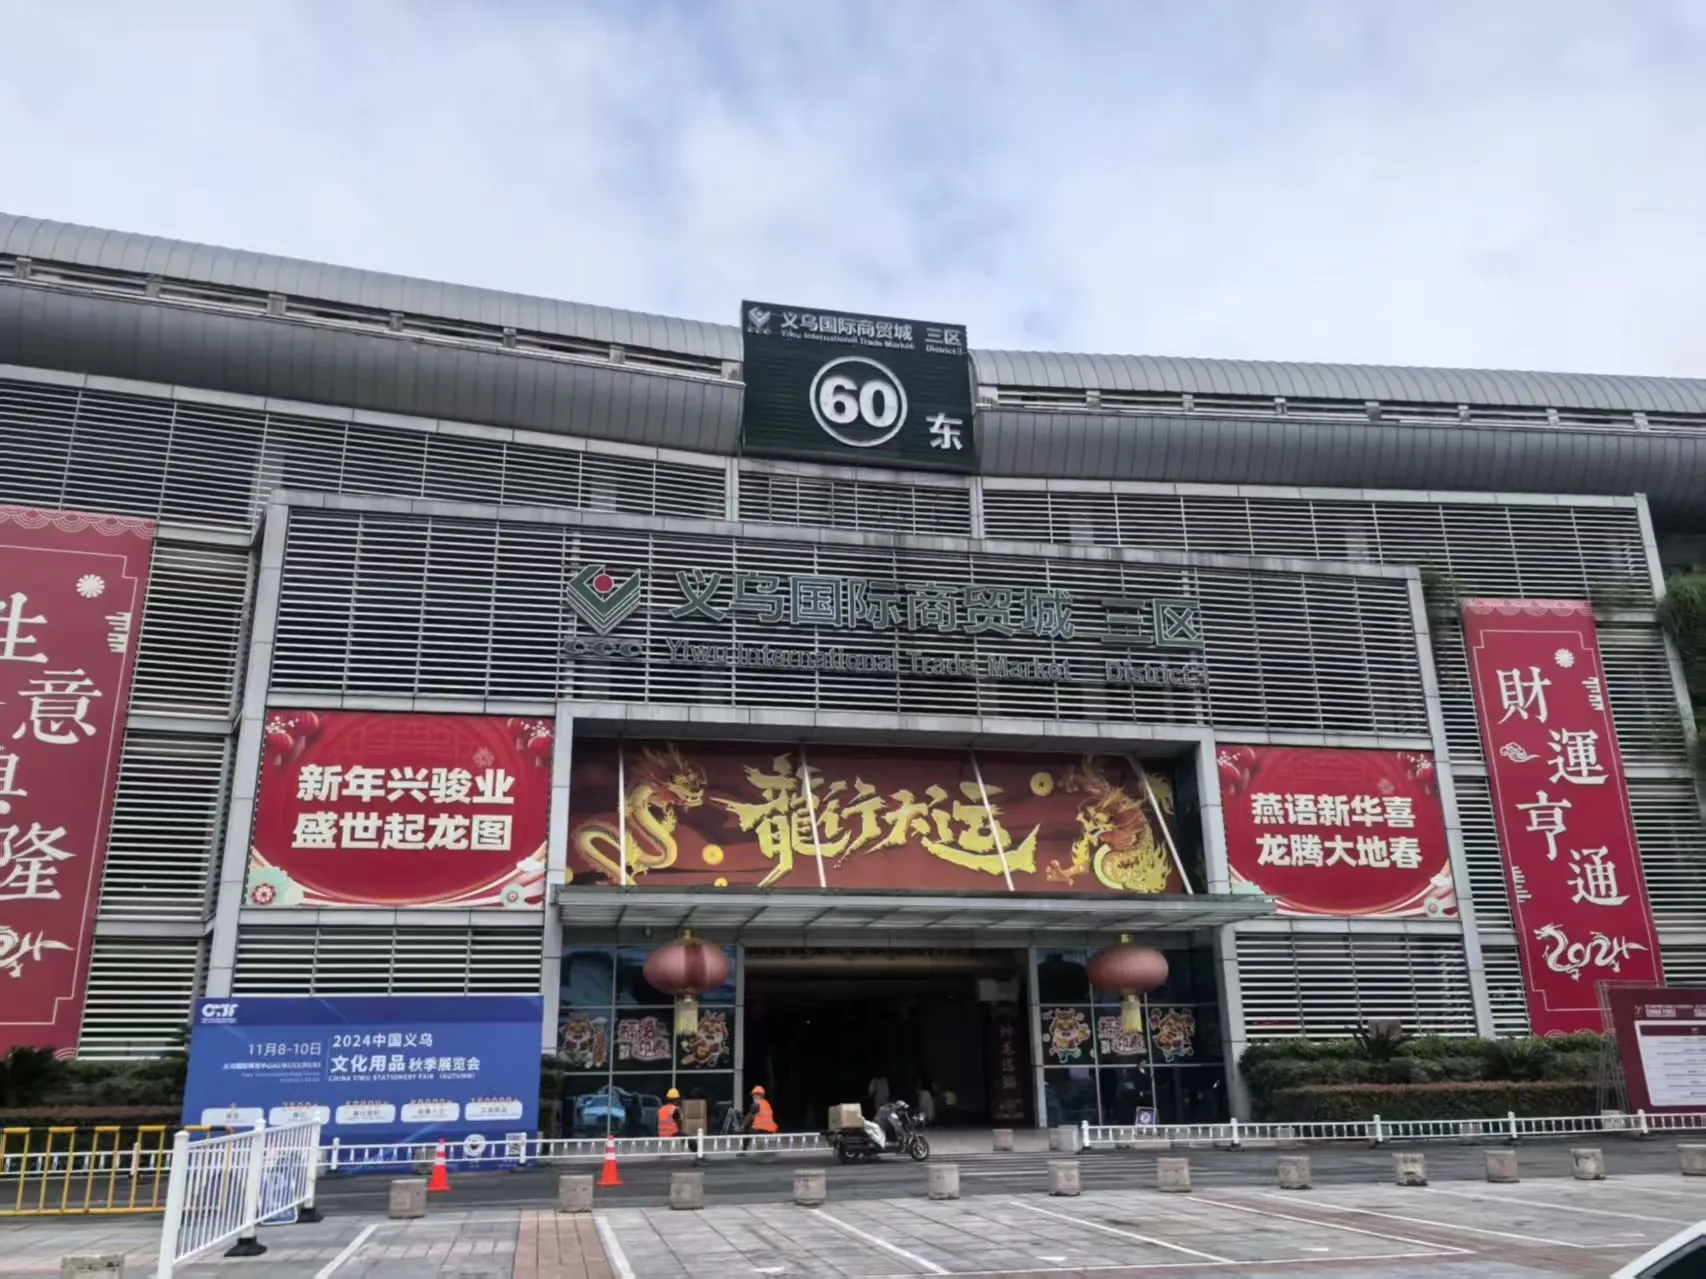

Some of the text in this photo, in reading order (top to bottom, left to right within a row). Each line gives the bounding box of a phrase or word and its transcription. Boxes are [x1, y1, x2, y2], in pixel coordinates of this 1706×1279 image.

[781, 312, 963, 346] 义乌国际商贸城 三区
[860, 337, 883, 348] Trade
[820, 376, 898, 428] 60
[926, 413, 963, 450] 东
[669, 568, 1205, 649] 义乌国际商贸城 三区
[665, 637, 728, 664] Yiwu
[738, 642, 899, 672] International
[906, 651, 977, 676] Trade
[987, 655, 1072, 681] Market
[1105, 660, 1190, 686] District
[297, 763, 516, 804] 新年兴骏业
[1250, 792, 1416, 828] 燕语新华喜
[291, 811, 513, 851] 盛世起龙图
[1256, 833, 1423, 869] 龙腾大地春
[248, 1042, 321, 1057] 11月8-10日
[332, 1032, 433, 1048] 2024中国义乌
